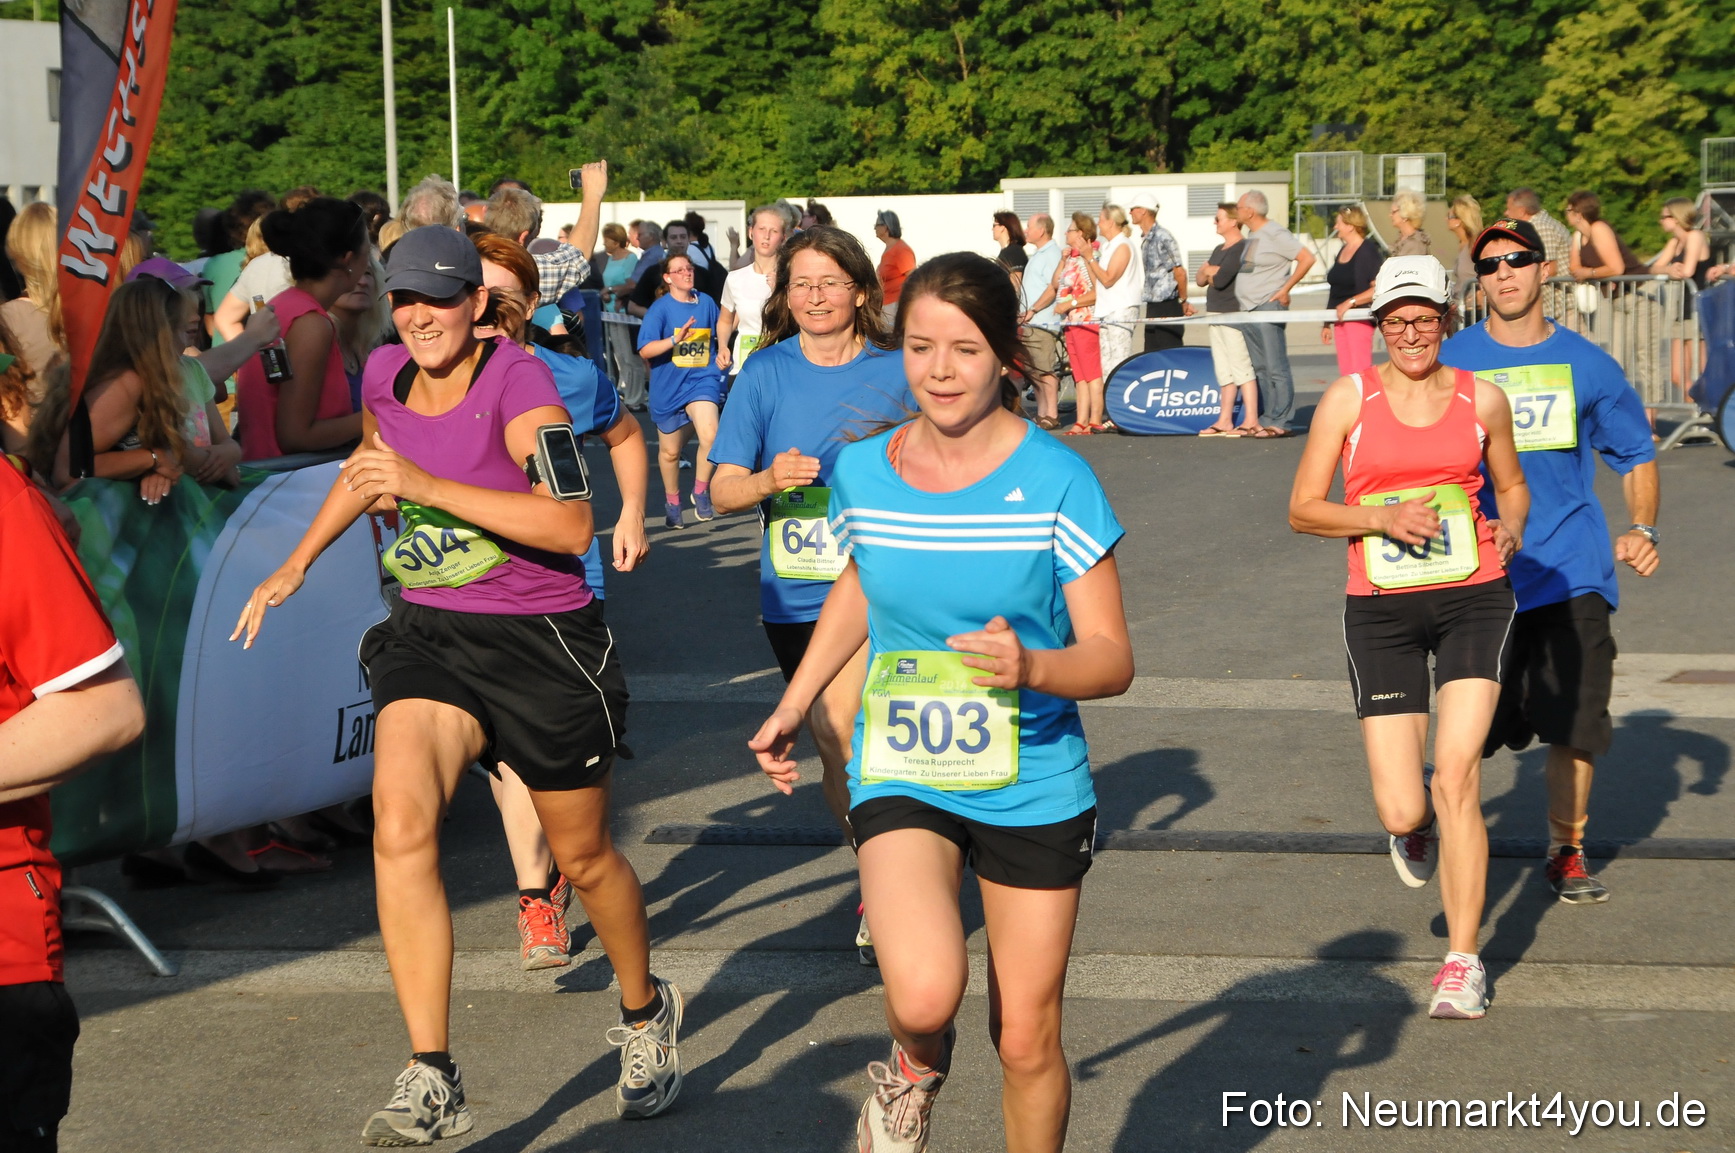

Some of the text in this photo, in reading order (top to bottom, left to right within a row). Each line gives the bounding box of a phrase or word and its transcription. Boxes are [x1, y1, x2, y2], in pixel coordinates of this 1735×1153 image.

[679, 342, 705, 357] 664
[1146, 385, 1241, 408] Fisch
[1155, 406, 1240, 417] AUTOMOBE
[782, 519, 845, 556] 64
[395, 528, 471, 571] 504
[408, 579, 438, 587] Kindergarten
[445, 567, 465, 581] Unserer
[466, 559, 484, 571] Lieben
[484, 553, 497, 563] Frau
[428, 560, 461, 577] Anja Zenger
[1374, 573, 1409, 581] Kindergarten
[1419, 568, 1440, 576] Unserer
[1441, 566, 1460, 574] Lieben
[886, 673, 938, 684] firmenlauf
[1371, 692, 1400, 701] CRAFT
[887, 700, 991, 755] 503
[903, 756, 975, 767] Teresa Rupprecht
[869, 766, 1009, 778] Kindergarten Zu Unserer Lieben Frau
